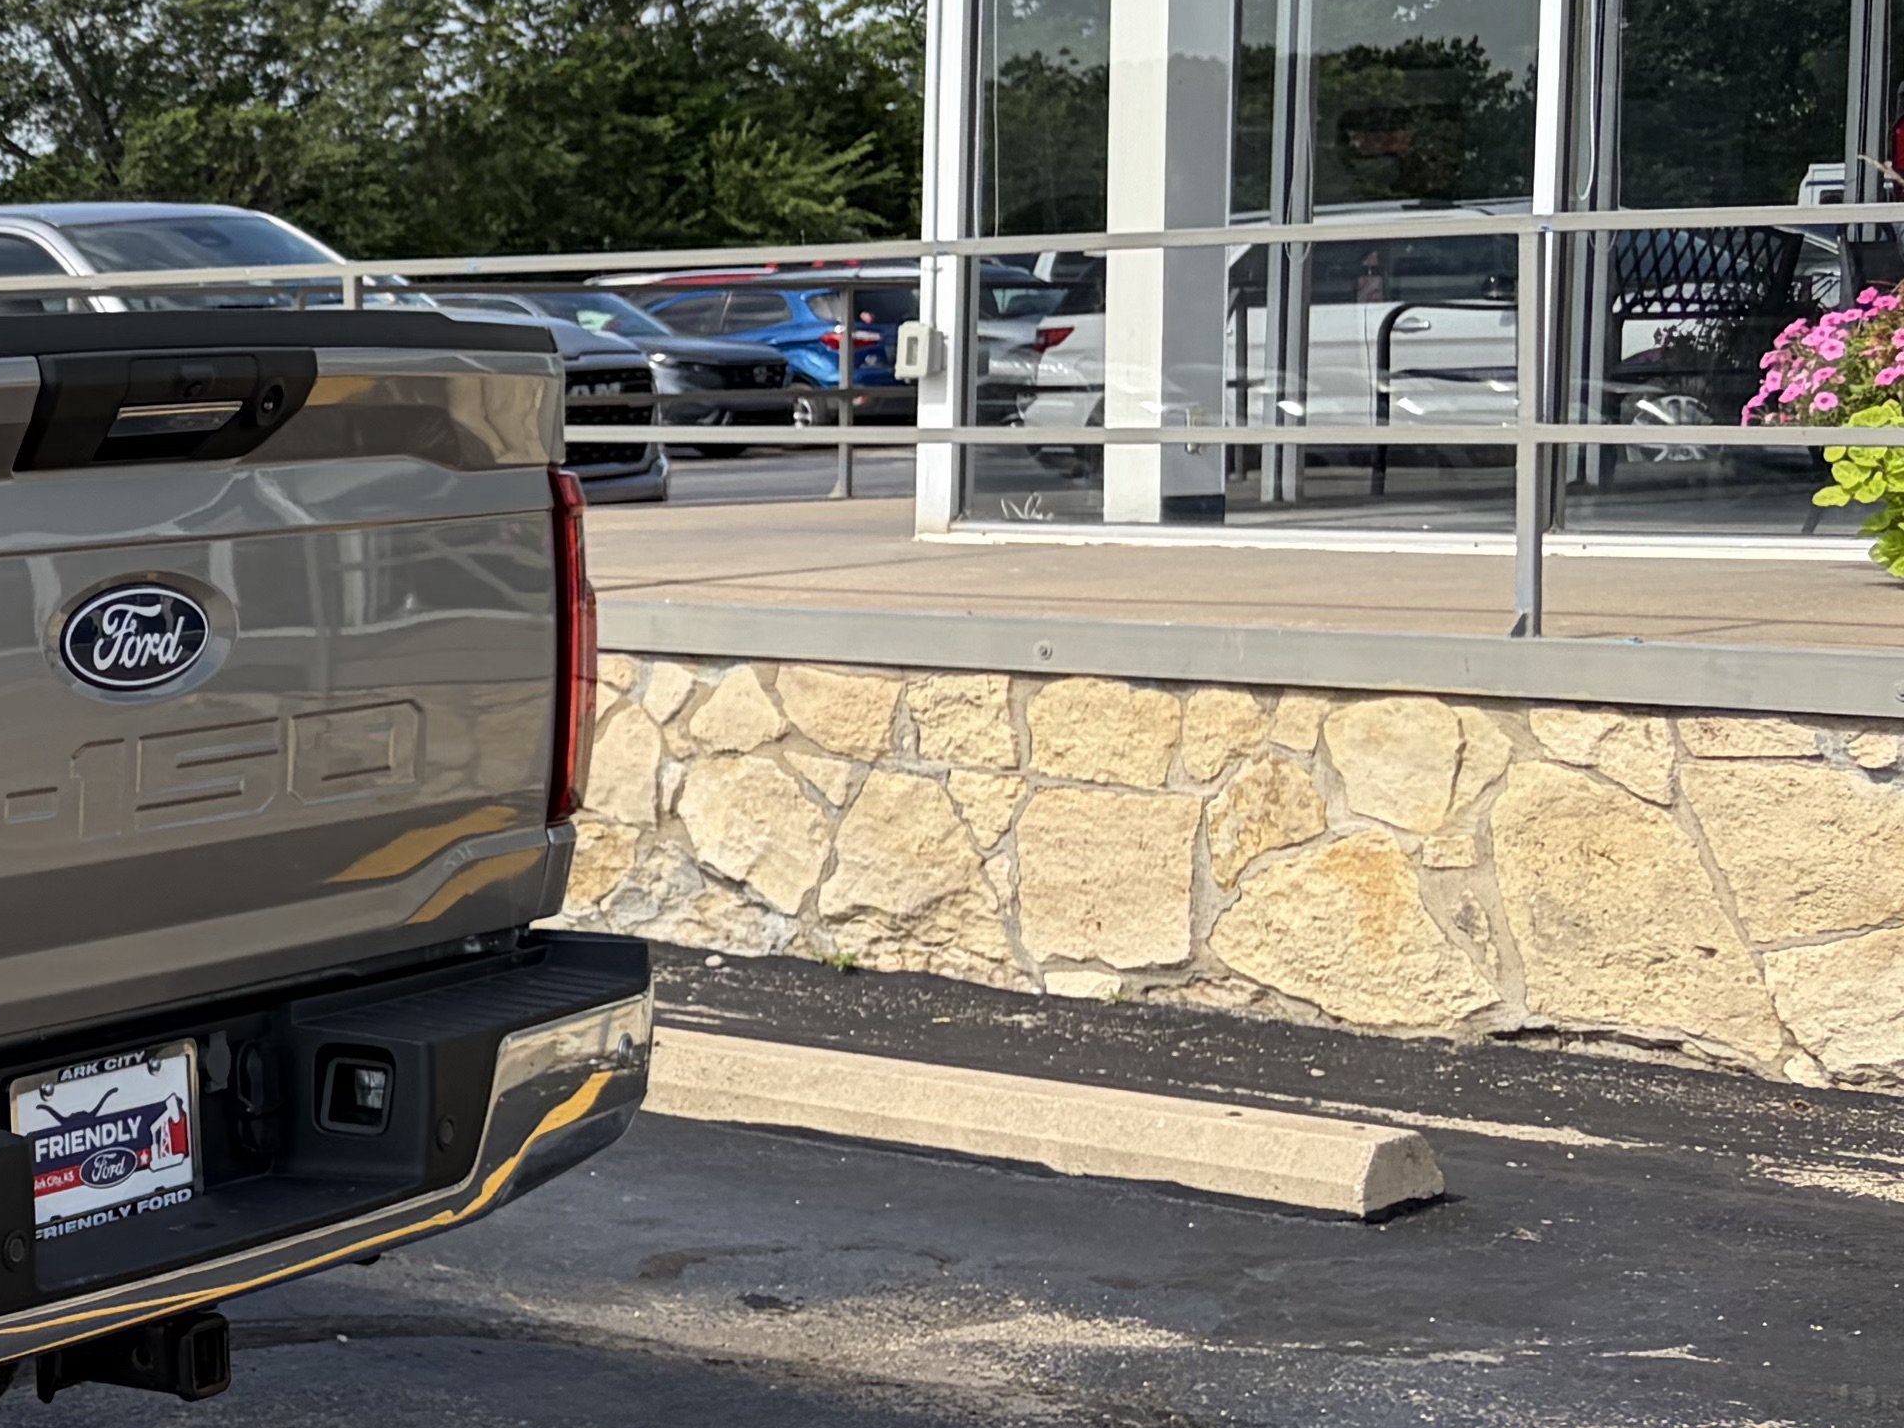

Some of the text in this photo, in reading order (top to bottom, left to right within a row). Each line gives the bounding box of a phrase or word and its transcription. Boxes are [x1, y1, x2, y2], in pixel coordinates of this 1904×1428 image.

[93, 603, 185, 671] Ford
[60, 1050, 147, 1082] ARK CITY
[35, 1115, 142, 1163] FRIENDLY
[91, 1153, 126, 1182] Ford
[137, 1187, 193, 1215] FORD
